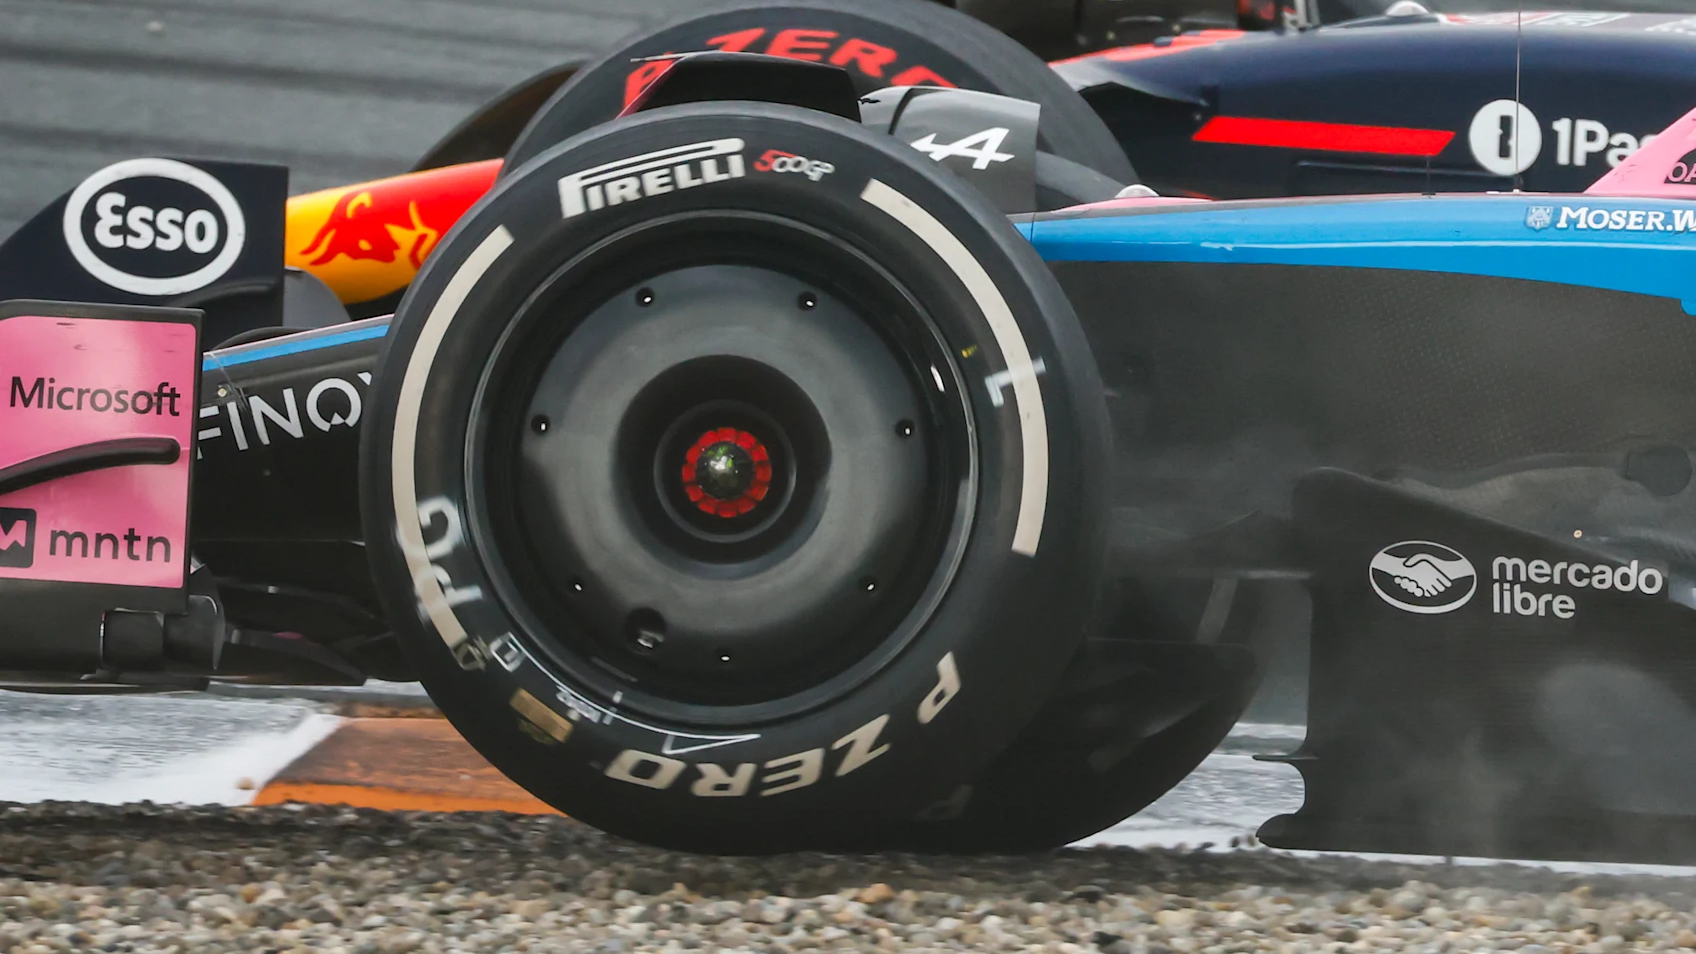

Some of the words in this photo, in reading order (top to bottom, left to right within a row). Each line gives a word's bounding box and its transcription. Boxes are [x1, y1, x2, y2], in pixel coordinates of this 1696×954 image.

[706, 28, 956, 88] ZER
[557, 137, 746, 219] PIRELLI
[95, 193, 219, 252] Esso
[9, 376, 181, 417] Microsoft
[196, 371, 373, 460] FINQ
[49, 528, 171, 563] mntn
[1492, 556, 1664, 595] mercado
[1492, 583, 1577, 619] libre
[604, 713, 892, 798] ZERO
